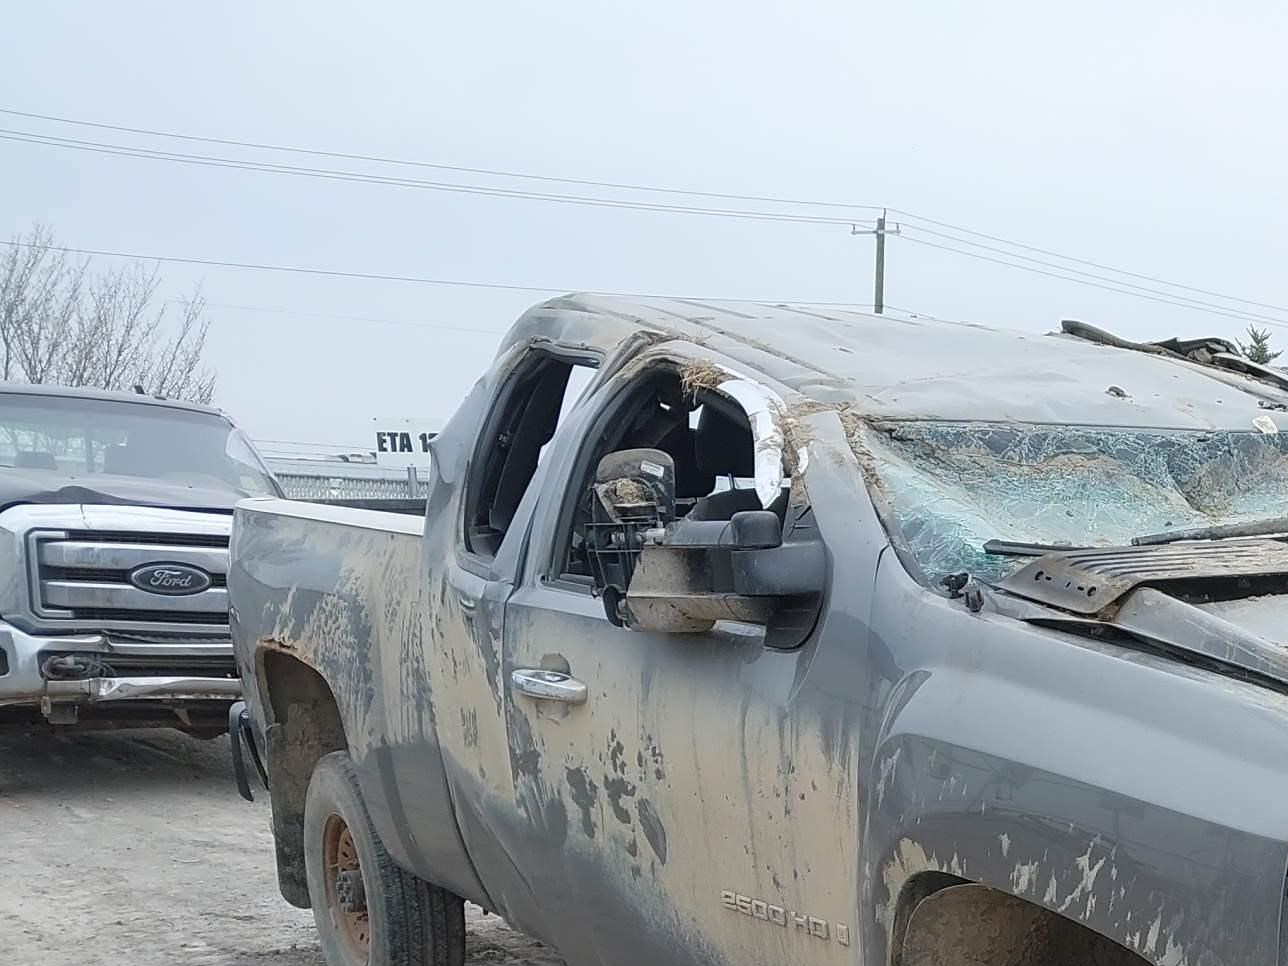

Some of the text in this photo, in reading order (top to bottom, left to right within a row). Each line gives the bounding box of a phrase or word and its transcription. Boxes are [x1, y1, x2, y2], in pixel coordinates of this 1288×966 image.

[377, 432, 414, 453] ETA
[150, 569, 193, 588] Ford
[720, 890, 788, 927] 2500
